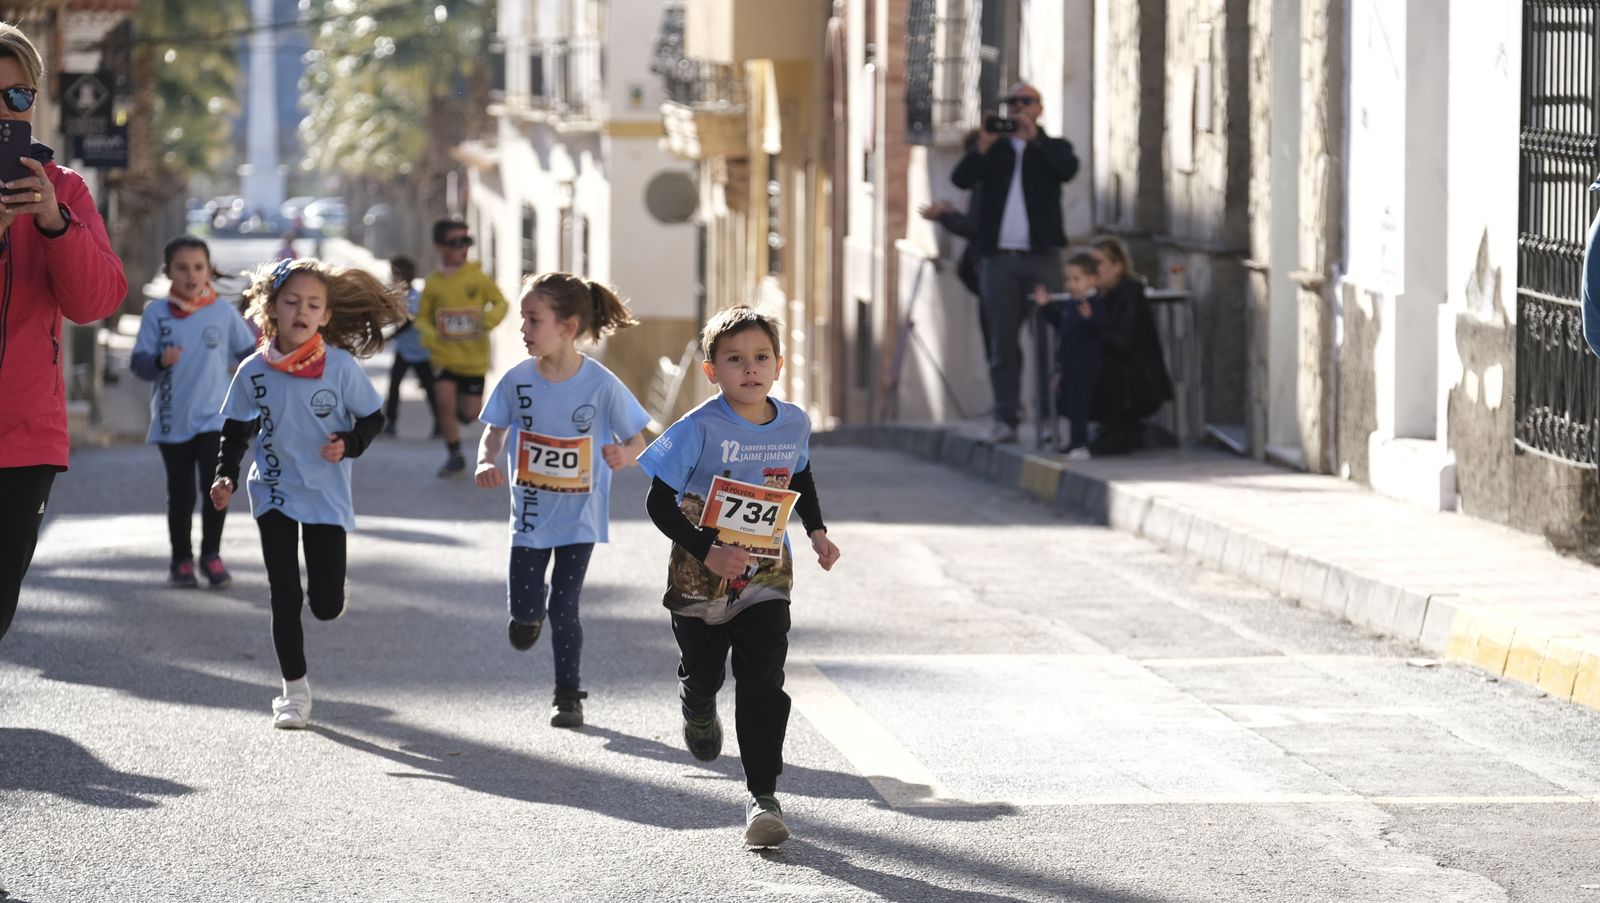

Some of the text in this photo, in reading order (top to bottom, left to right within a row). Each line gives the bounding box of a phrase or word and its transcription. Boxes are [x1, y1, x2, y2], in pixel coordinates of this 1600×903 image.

[158, 317, 173, 338] LA
[250, 373, 268, 399] LA
[516, 384, 533, 409] LA
[530, 445, 579, 469] 720
[720, 439, 740, 463] 12
[741, 444, 766, 452] CARRERA
[739, 451, 763, 463] JAIME
[724, 496, 779, 526] 734
